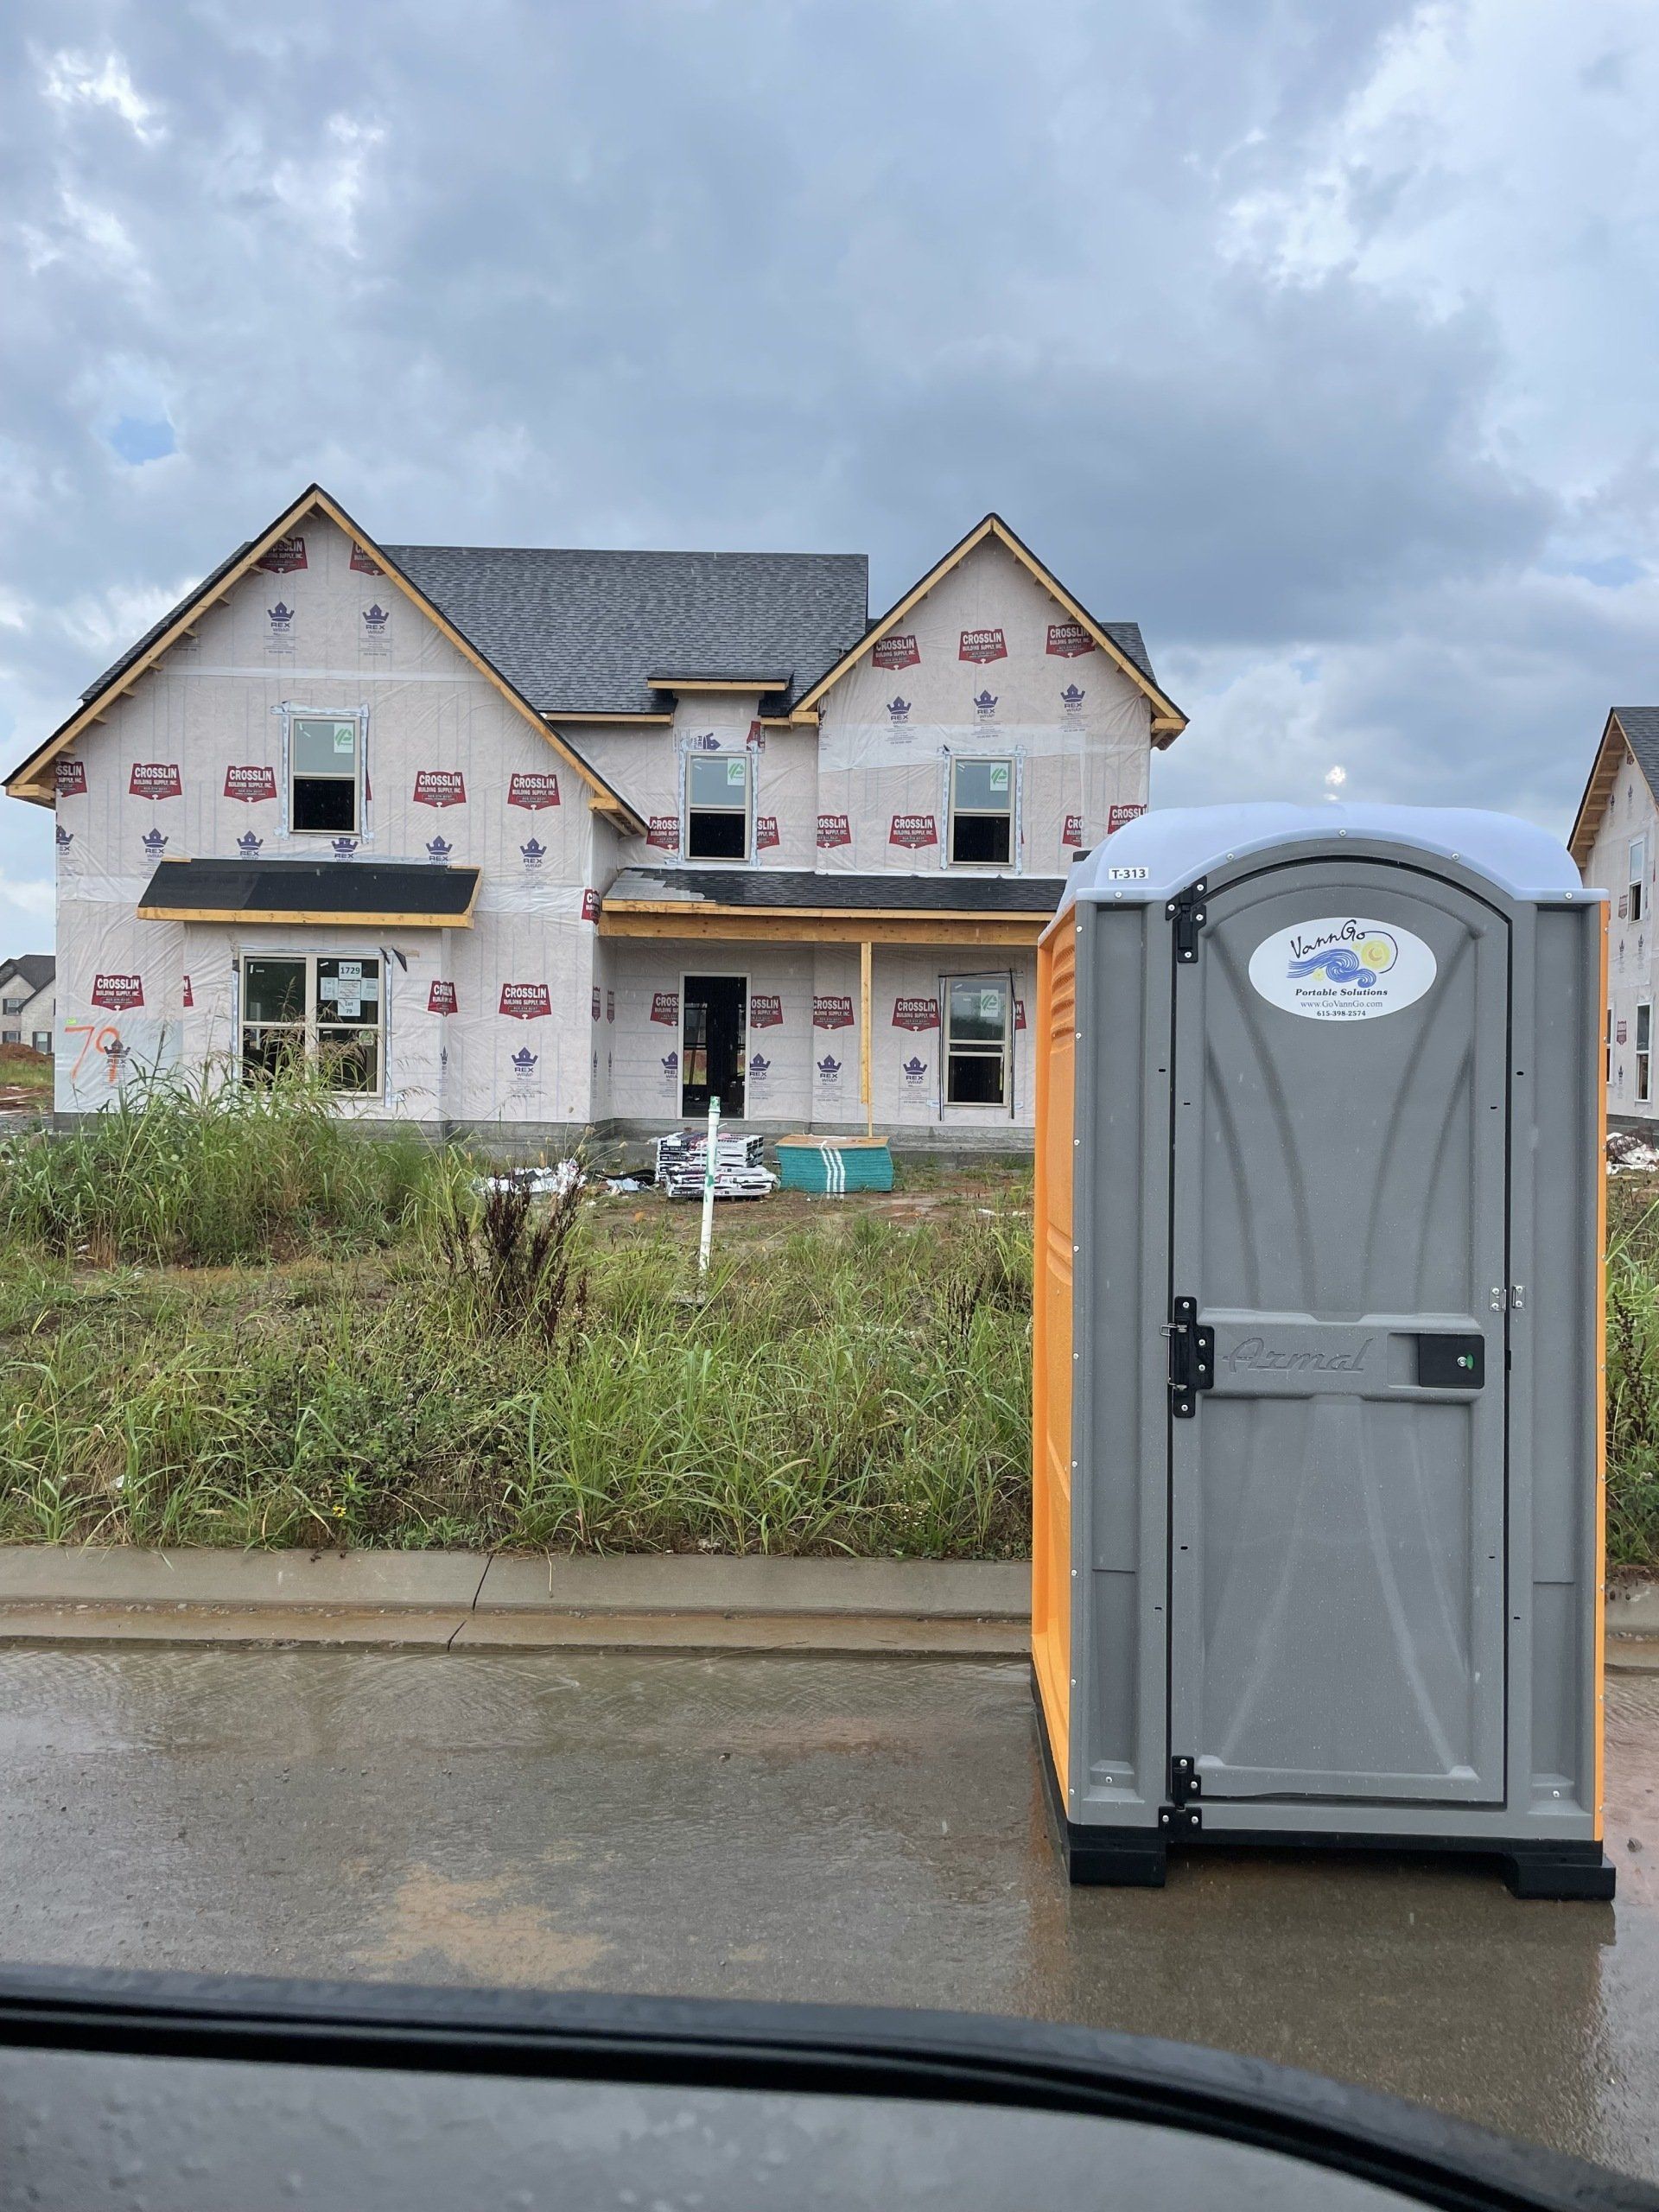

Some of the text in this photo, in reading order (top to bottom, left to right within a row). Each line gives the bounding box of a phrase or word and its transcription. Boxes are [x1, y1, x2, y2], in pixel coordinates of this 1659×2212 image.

[963, 632, 1001, 645] CROSSLIN
[135, 767, 177, 779] CROSSLIN
[229, 769, 272, 781] CROSSLIN
[419, 774, 461, 786] CROSSLIN
[513, 778, 555, 789] CROSSLIN
[819, 818, 847, 829] OSSLIN
[894, 819, 932, 830] CROSSLIN
[1112, 868, 1146, 879] T-313
[1290, 918, 1366, 958] VannGo
[97, 978, 139, 989] CROSSLIN
[505, 988, 546, 999] CROSSLIN
[752, 999, 778, 1009] OSSLIN
[897, 1001, 935, 1012] CROSSLIN
[65, 1026, 120, 1082] 79
[1222, 1337, 1375, 1374] Armal
